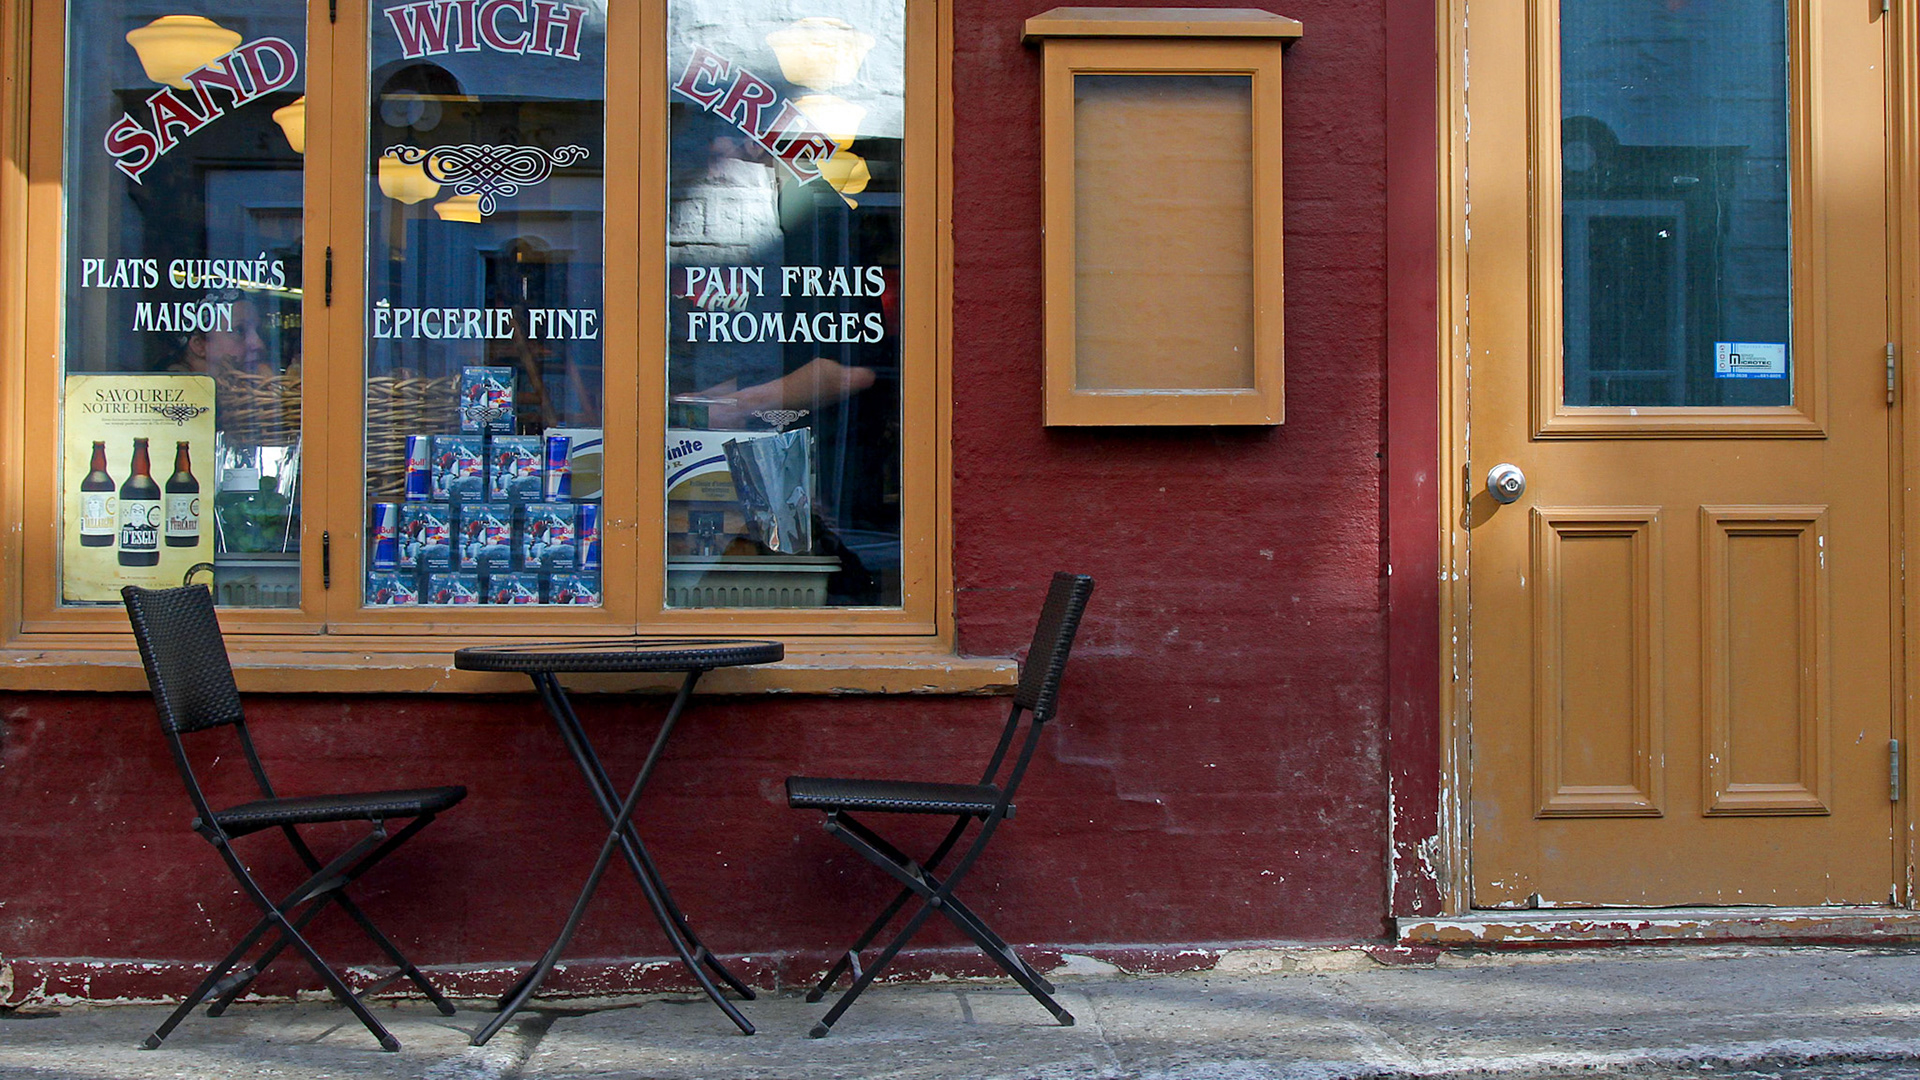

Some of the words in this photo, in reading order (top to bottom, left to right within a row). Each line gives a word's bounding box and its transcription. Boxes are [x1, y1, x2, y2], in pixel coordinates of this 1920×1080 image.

[104, 36, 299, 185] SAND
[384, 0, 589, 61] WICH
[672, 43, 842, 187] ERIE
[81, 258, 160, 289] PLATS
[168, 251, 286, 290] CUISINÉS
[685, 266, 765, 297] PAIN
[780, 266, 886, 297] FRAIS
[132, 302, 233, 332] MAISON
[372, 298, 515, 340] ÉPICERIE
[528, 308, 599, 340] FINE
[687, 312, 885, 343] FROMAGES
[83, 403, 130, 413] NOTRE
[95, 389, 185, 402] SAVOUREZ
